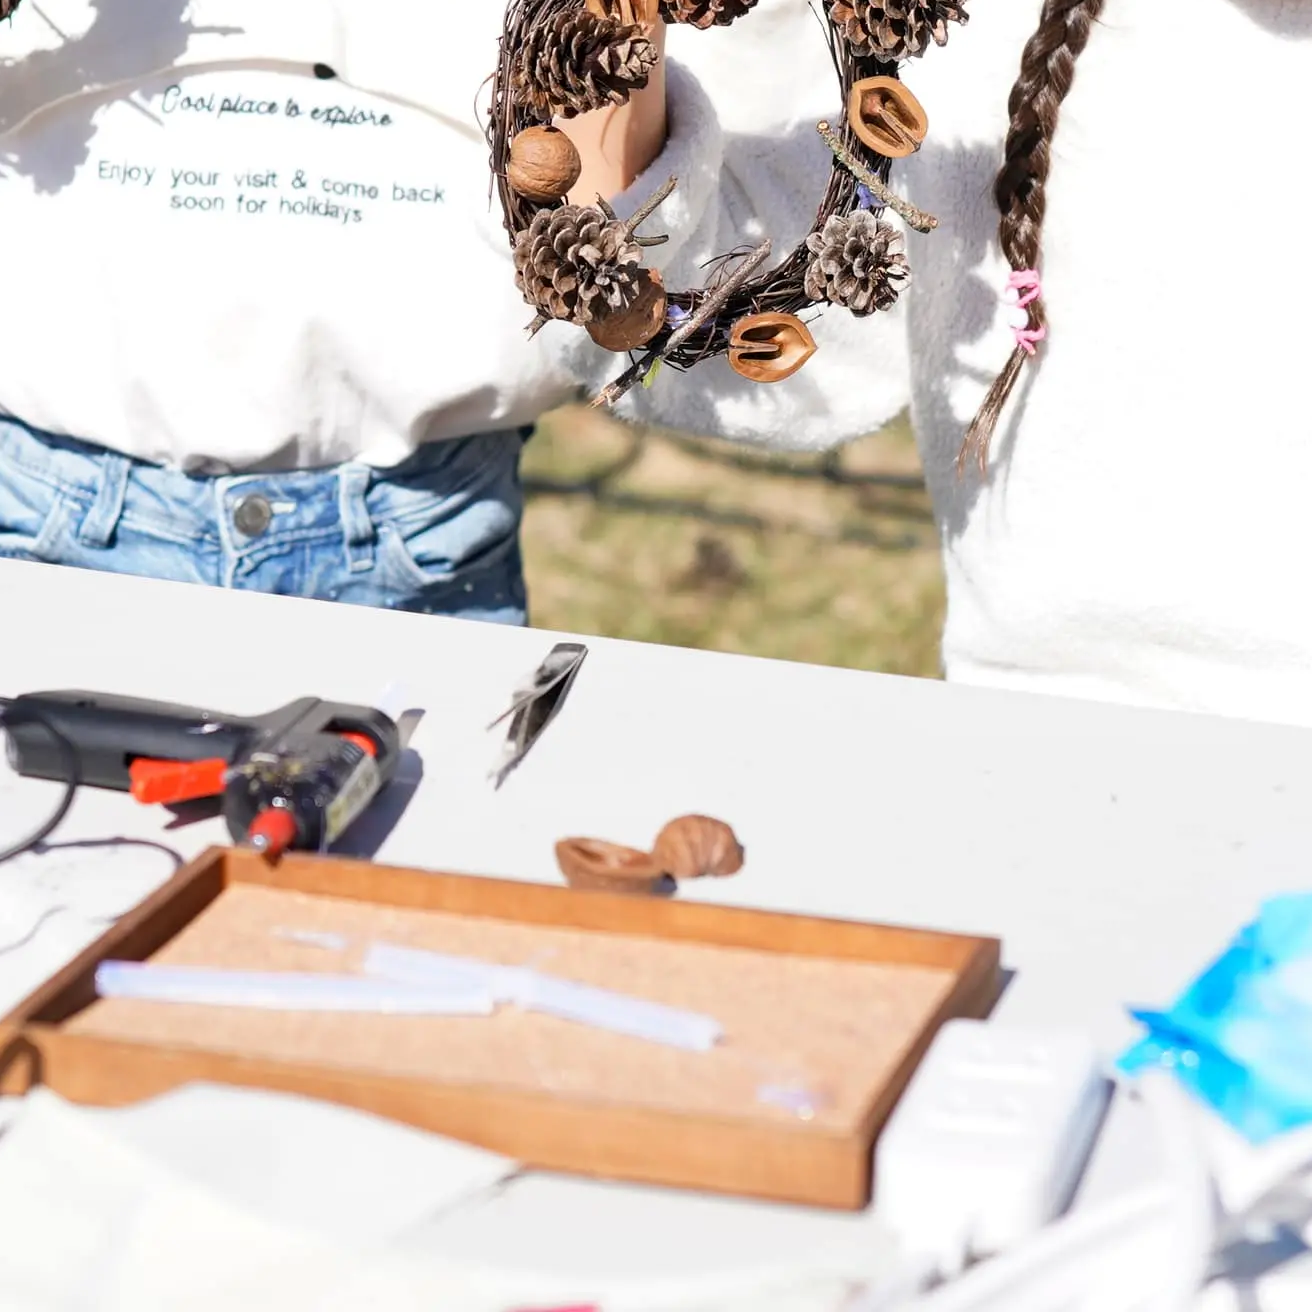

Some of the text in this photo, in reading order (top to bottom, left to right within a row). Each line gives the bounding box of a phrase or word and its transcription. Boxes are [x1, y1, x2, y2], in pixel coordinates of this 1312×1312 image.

[161, 84, 392, 128] Cool place to explore
[98, 160, 445, 203] Enjoy your visit & come back
[170, 193, 362, 224] soon for holidays
